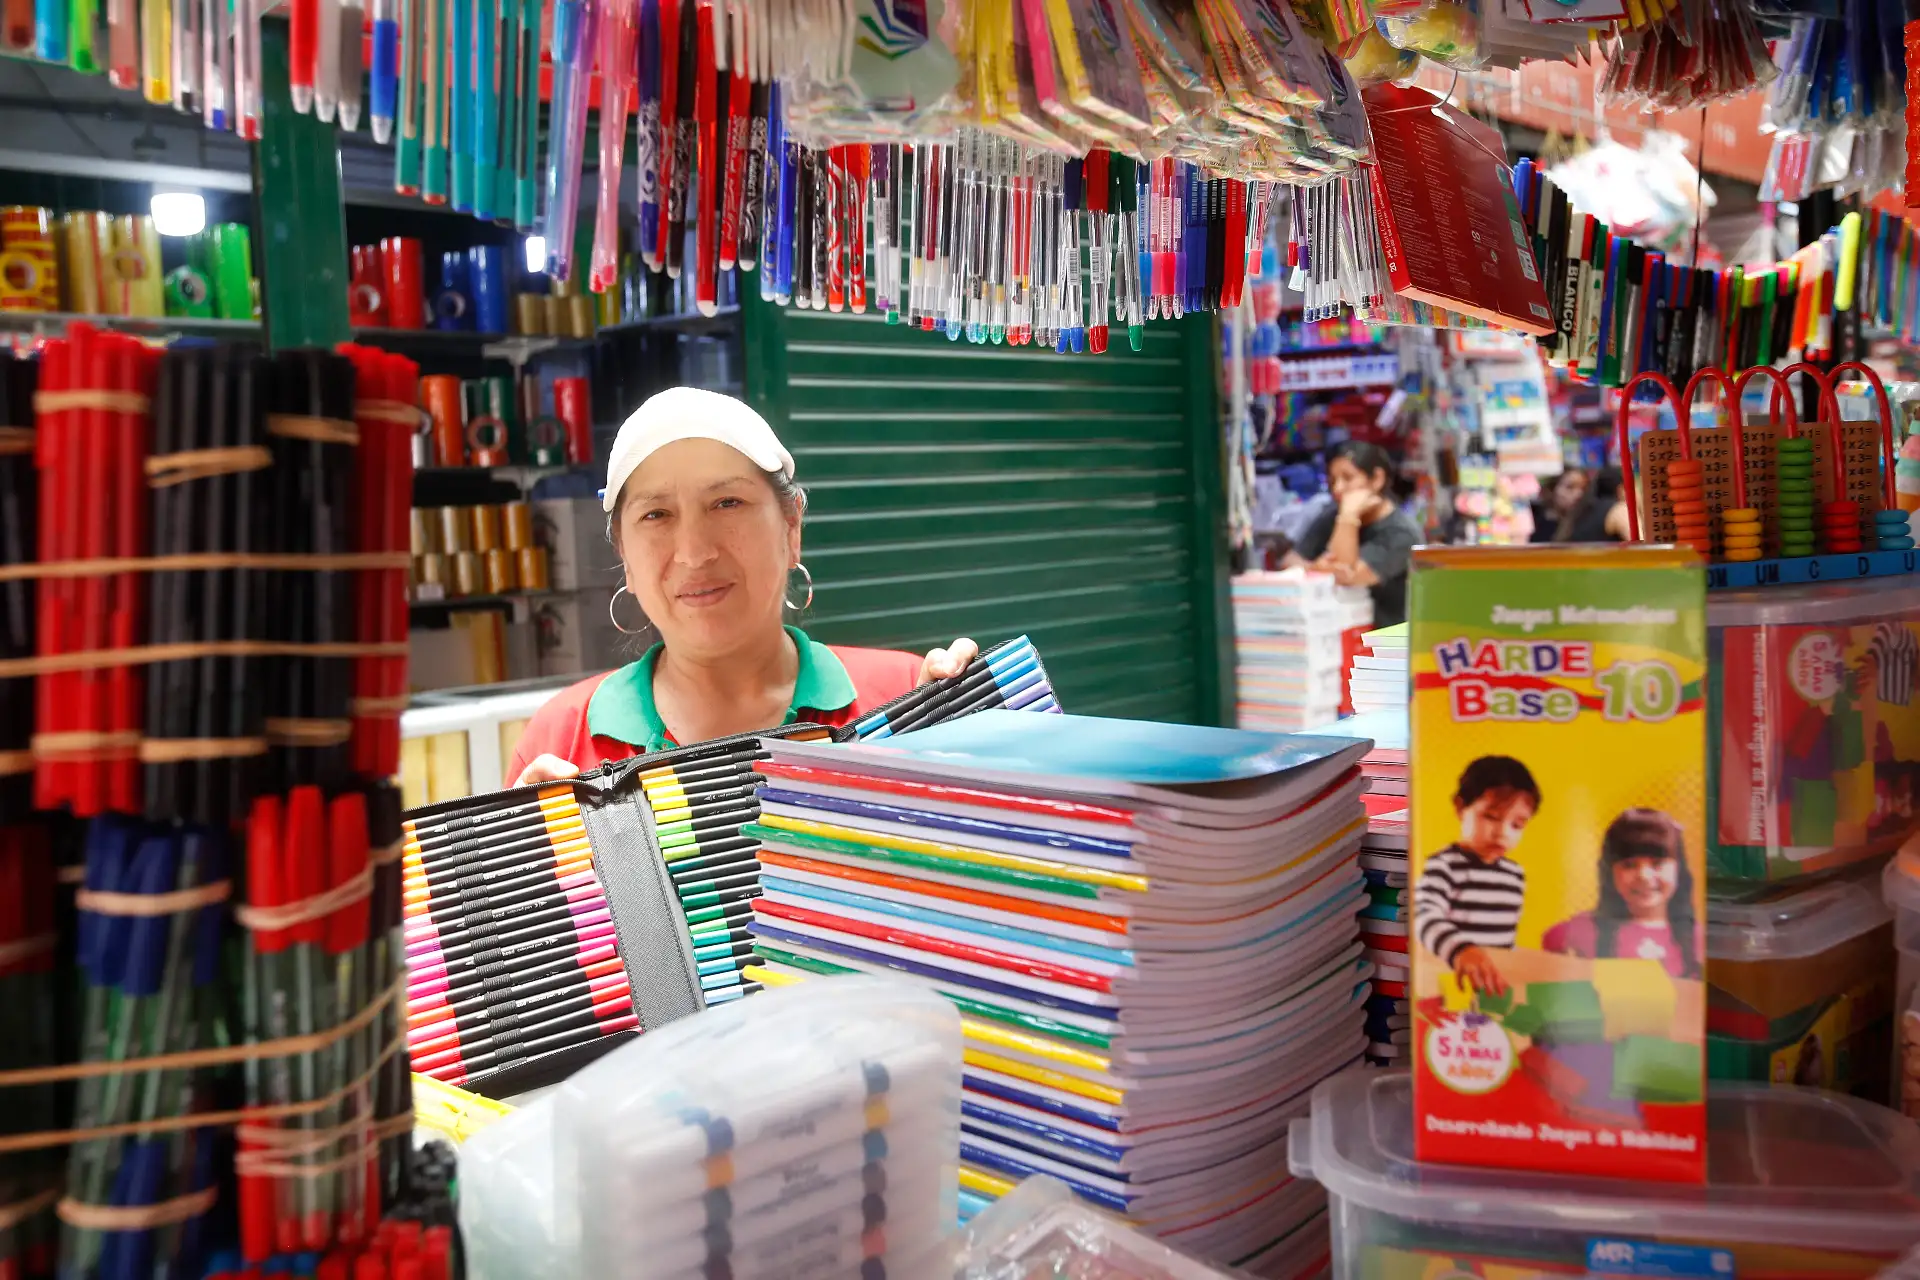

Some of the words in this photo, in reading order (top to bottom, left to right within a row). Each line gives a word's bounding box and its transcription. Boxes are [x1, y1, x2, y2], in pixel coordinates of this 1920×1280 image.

[1562, 266, 1579, 331] BLANCO
[1756, 564, 1780, 584] UM
[1809, 560, 1820, 579] C
[1858, 556, 1870, 575] D
[1904, 551, 1915, 571] U
[1437, 639, 1590, 675] HARDE
[1453, 681, 1576, 719] Base
[1597, 661, 1679, 721] 10
[1437, 1035, 1451, 1057] 5
